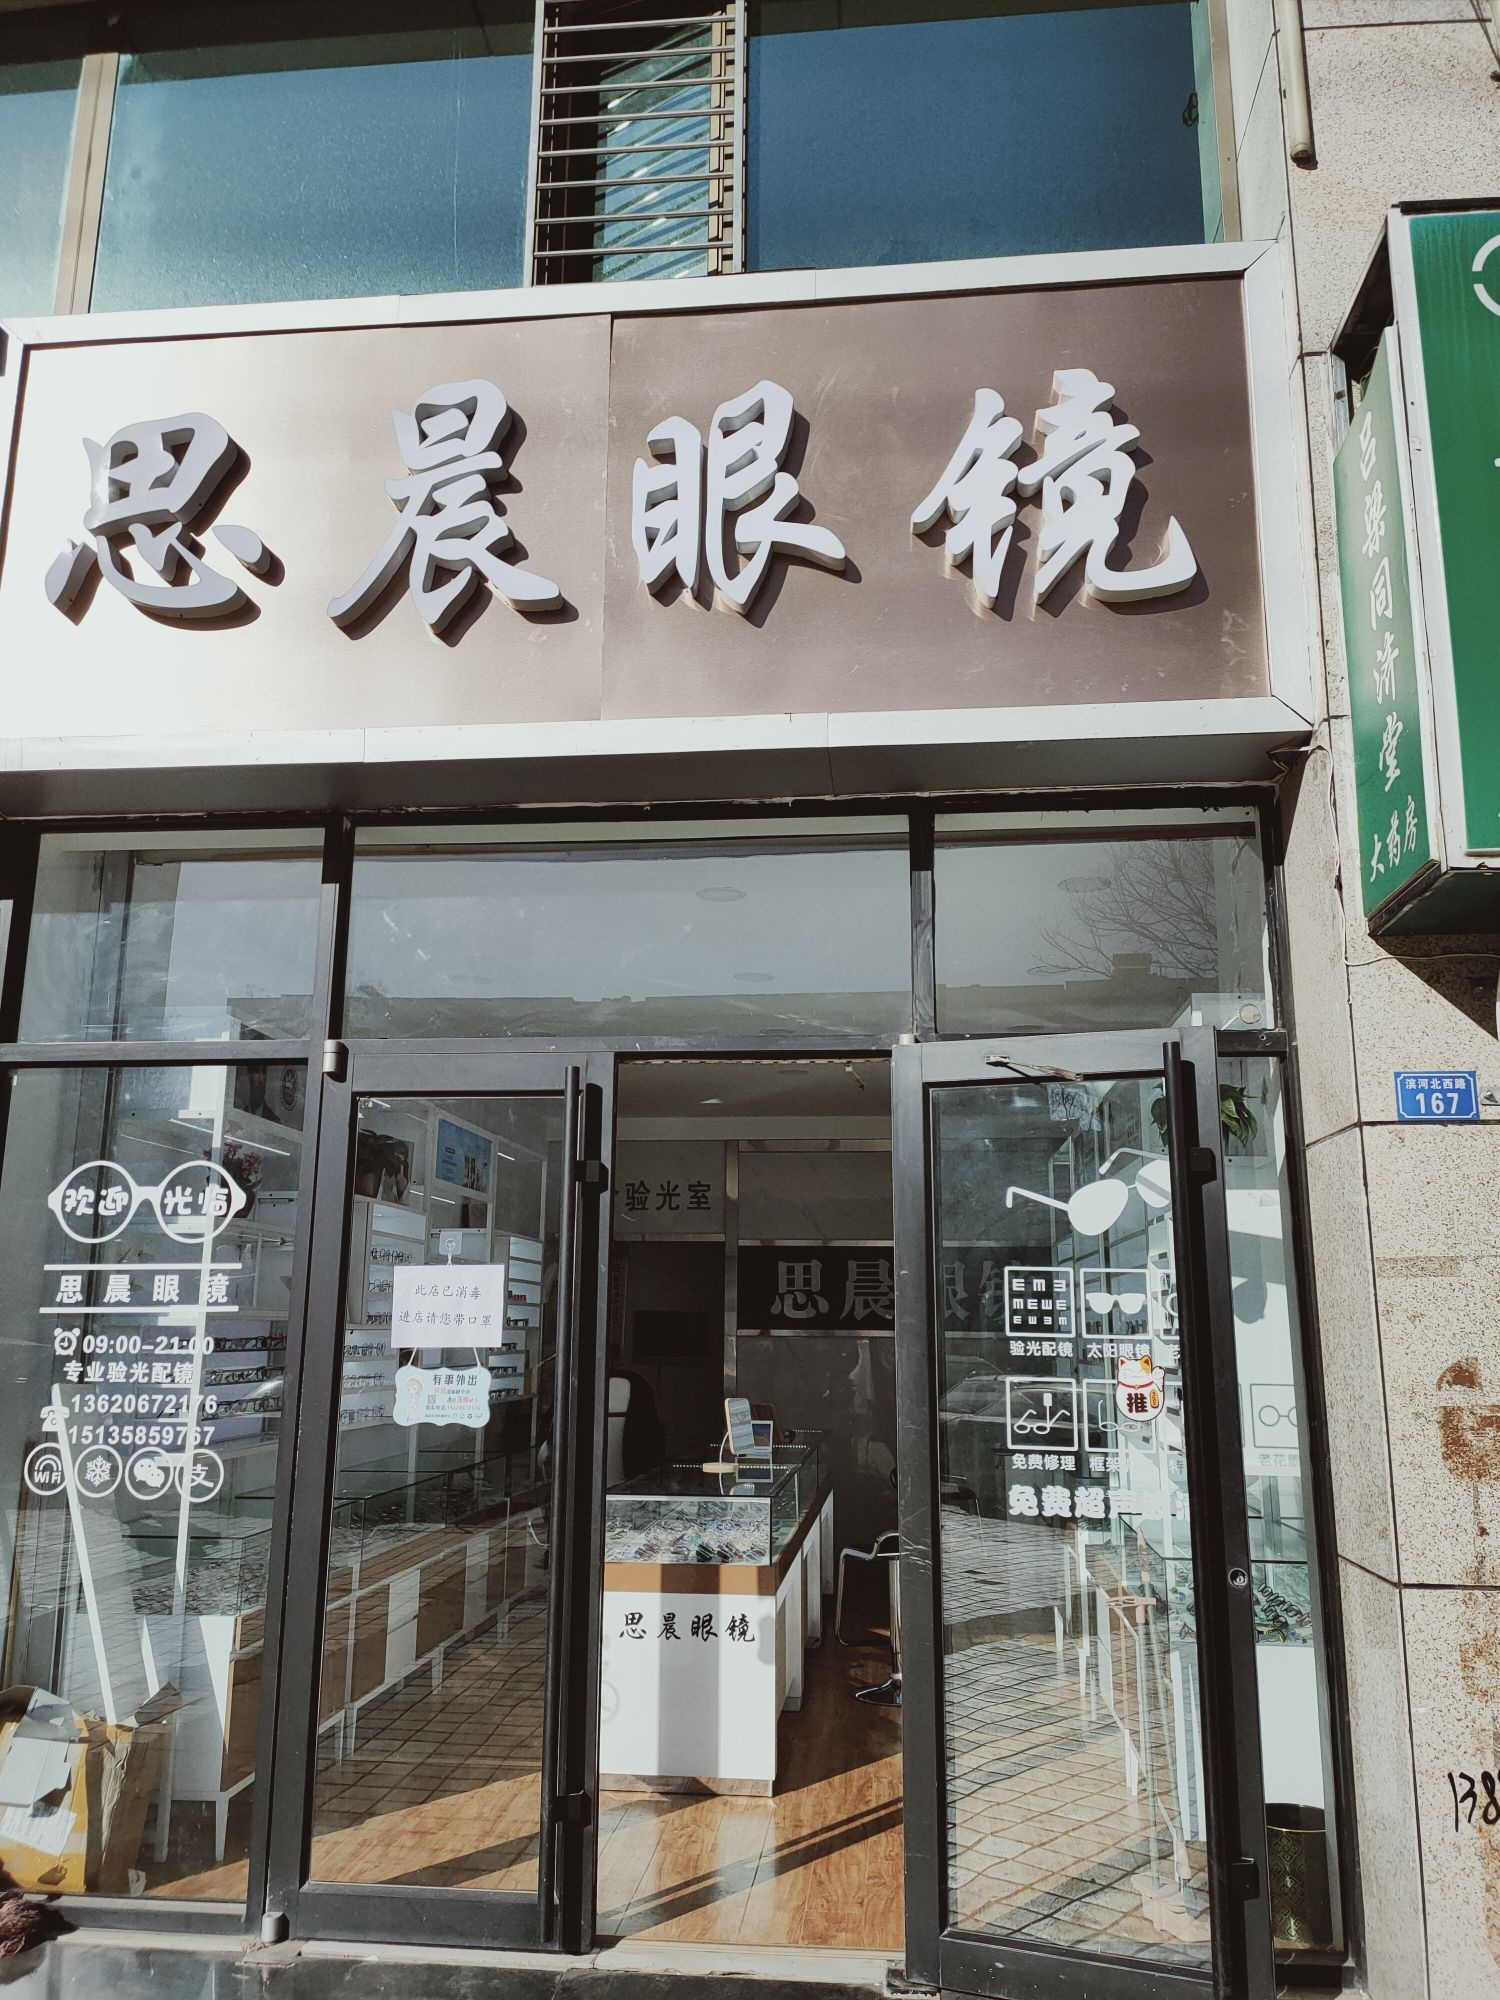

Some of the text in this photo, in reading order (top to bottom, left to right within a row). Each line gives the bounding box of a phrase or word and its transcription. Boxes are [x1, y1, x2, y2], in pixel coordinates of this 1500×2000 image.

[46, 368, 1198, 628] 思晨眼镜
[1360, 411, 1403, 792] 吕梁同济堂
[1370, 795, 1418, 883] 大药房
[1405, 1078, 1466, 1090] 滨河北西路
[1415, 1092, 1459, 1114] 167
[65, 1185, 228, 1216] 欢迎光临
[625, 1180, 712, 1211] 验光室
[56, 1273, 230, 1304] 思晨眼镜
[414, 1284, 482, 1300] 此店已消毒
[398, 1310, 492, 1327] 进店请您带口罩
[82, 1335, 215, 1355] 09:00-21:00
[1009, 1340, 1073, 1358] 验光配镜
[1086, 1342, 1151, 1358] 太阳眼镜
[63, 1360, 195, 1383] 专业验光配镜
[432, 1374, 477, 1386] 有事外出
[71, 1394, 217, 1414] 13620672176
[1126, 1392, 1149, 1413] 推
[68, 1425, 215, 1445] 15135859767
[1011, 1453, 1076, 1471] 免费修理
[619, 1611, 756, 1643] 思晨眼镜
[1447, 1769, 1500, 1832] 138
